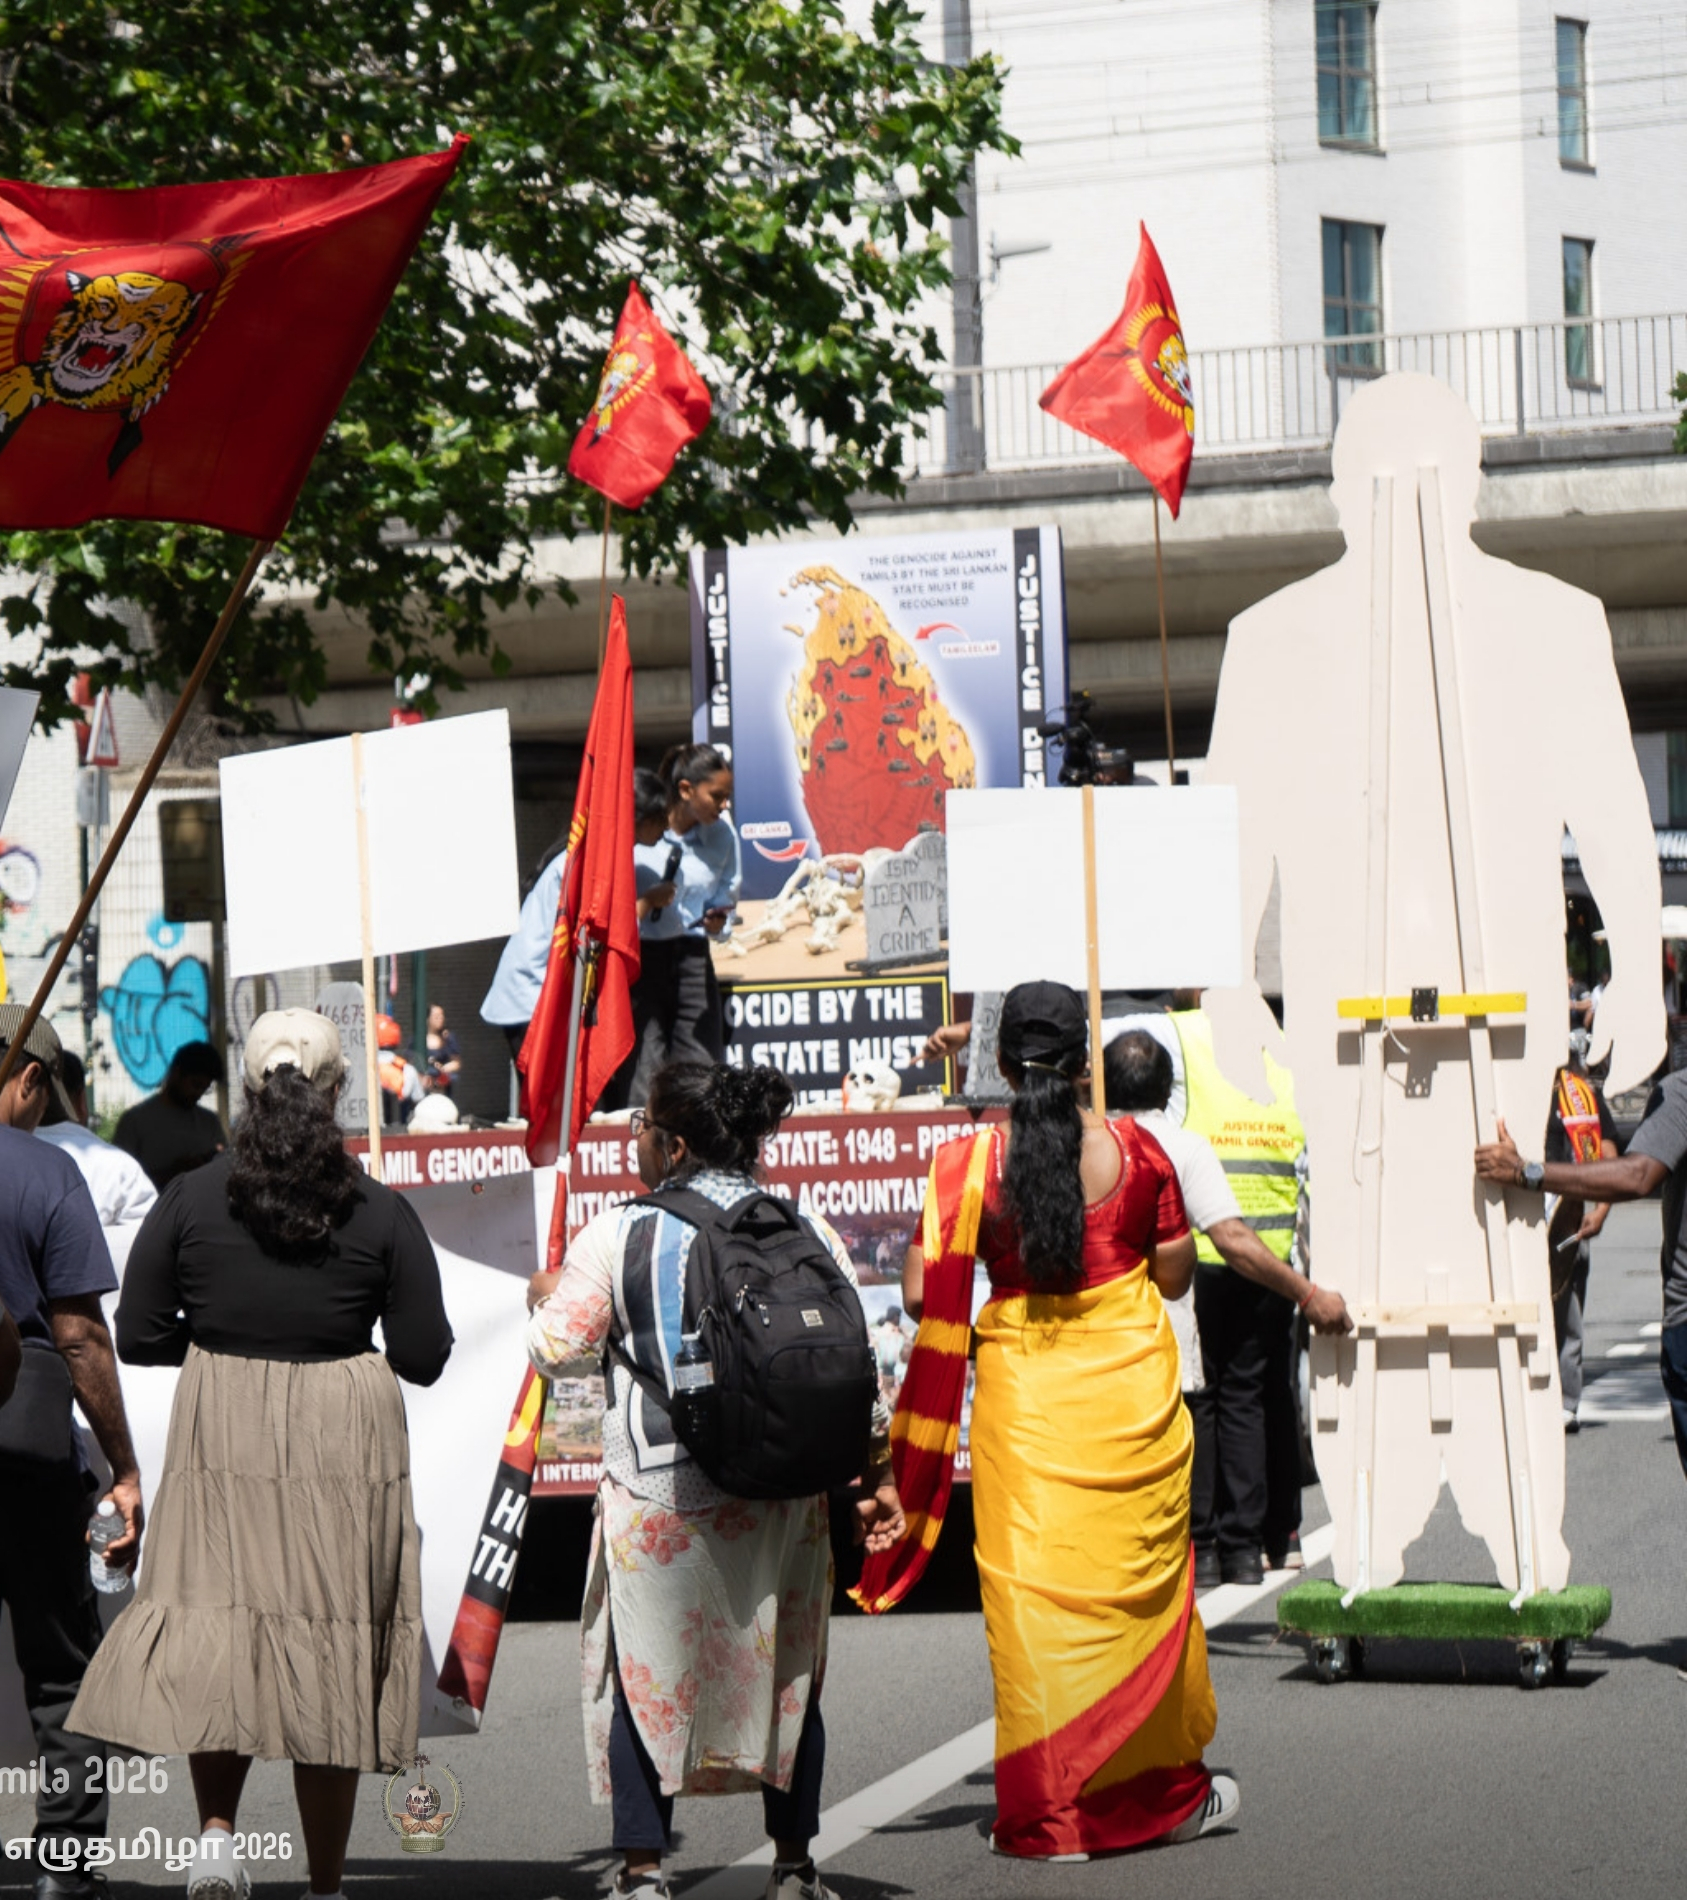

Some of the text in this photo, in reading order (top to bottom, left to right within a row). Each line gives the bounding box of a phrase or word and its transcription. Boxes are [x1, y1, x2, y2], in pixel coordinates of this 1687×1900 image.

[869, 548, 997, 566] THE GENOCIDE AGAINST
[860, 563, 1008, 582] TAMILS BY THE SRI LANKAN
[893, 581, 975, 595] STATE MUST BE
[899, 596, 969, 610] RECOGNISED
[1018, 554, 1042, 712] JUSTICE
[708, 573, 730, 727] JUSTICE
[898, 904, 916, 928] A
[879, 928, 934, 954] CRIME
[818, 989, 857, 1023] BY
[865, 986, 923, 1022] THE
[752, 1039, 840, 1074] STATE
[848, 1035, 928, 1074] MUST
[1223, 1121, 1286, 1133] JUSTICE FOR
[1210, 1136, 1296, 1149] TAMIL GENOCIDE
[427, 1145, 532, 1183] GENOCID
[577, 1141, 623, 1176] THE
[764, 1130, 839, 1168] STATE:
[845, 1127, 896, 1164] 1948
